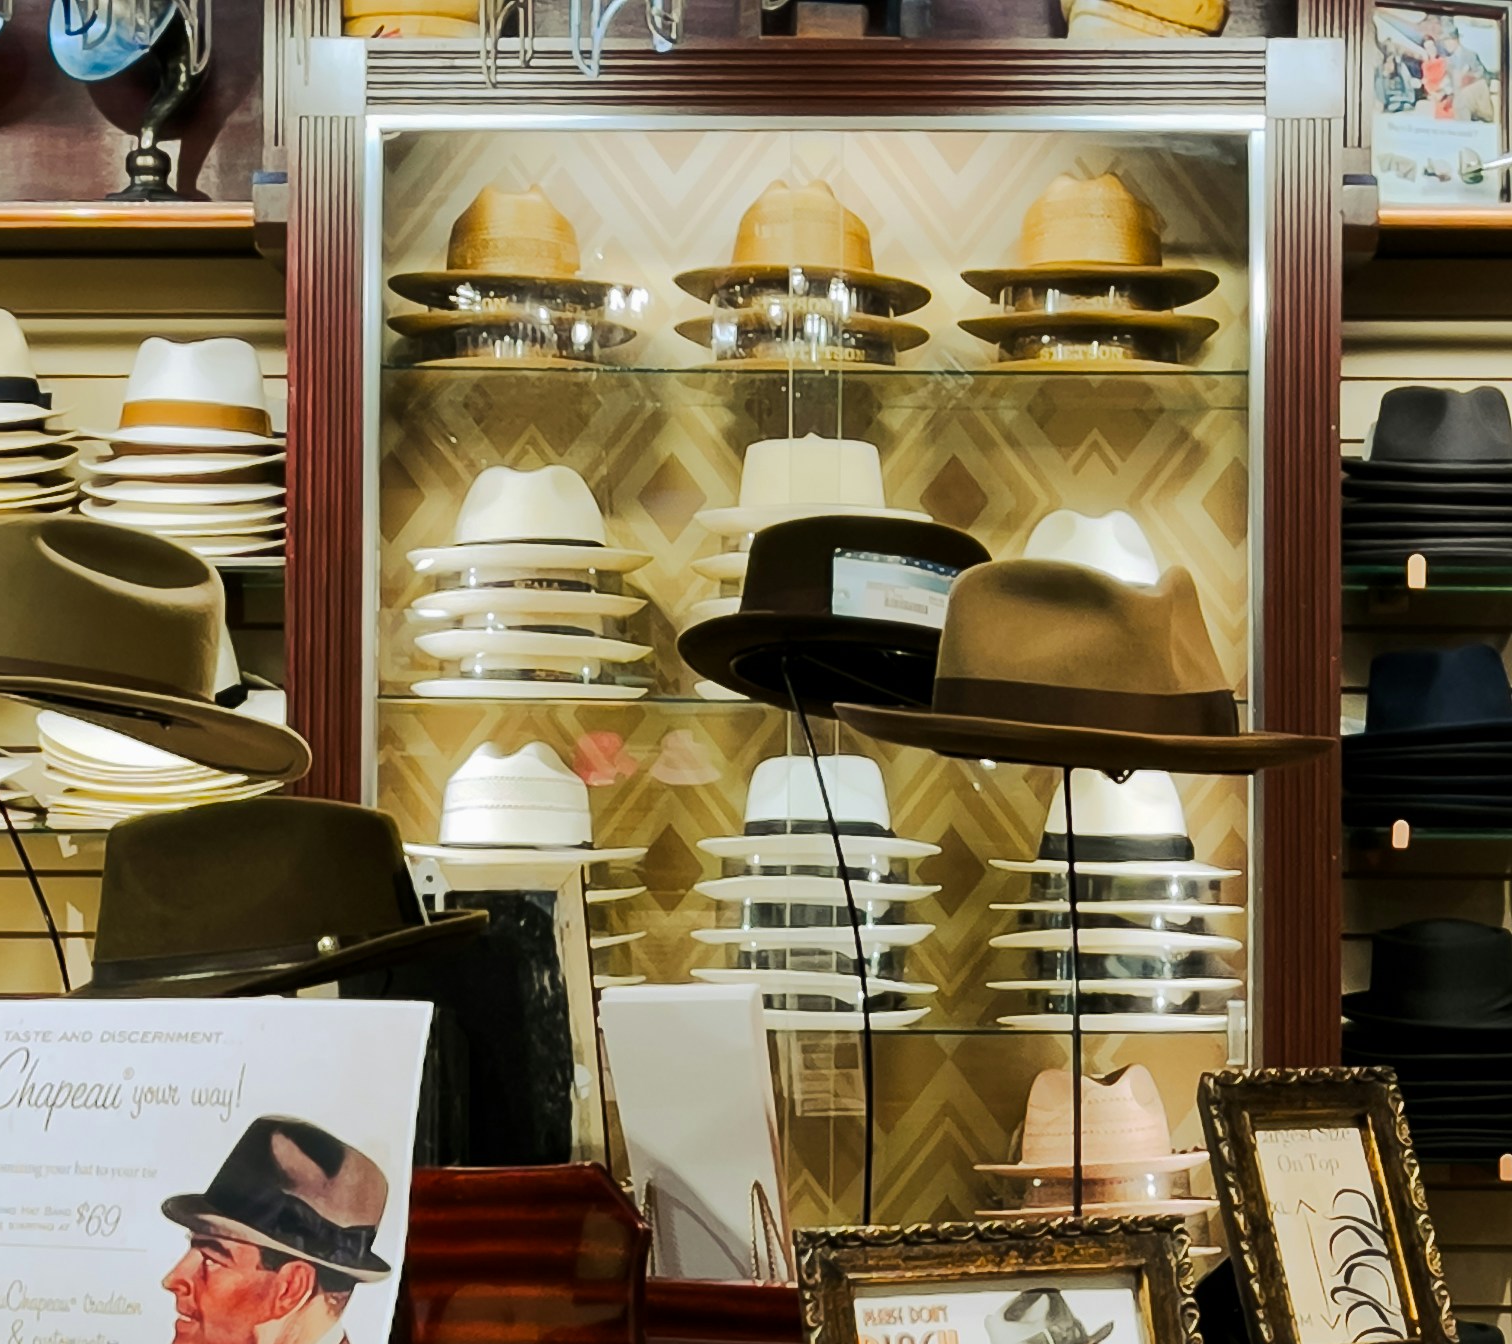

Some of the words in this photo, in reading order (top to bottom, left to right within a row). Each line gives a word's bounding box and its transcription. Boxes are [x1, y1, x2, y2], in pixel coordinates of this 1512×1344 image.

[4, 1030, 53, 1043] TASTE
[58, 1031, 93, 1043] AND
[130, 1083, 181, 1119] your
[191, 1062, 246, 1122] way!
[1277, 1153, 1303, 1173] On
[1304, 1153, 1340, 1176] Top
[75, 1200, 123, 1238] $69
